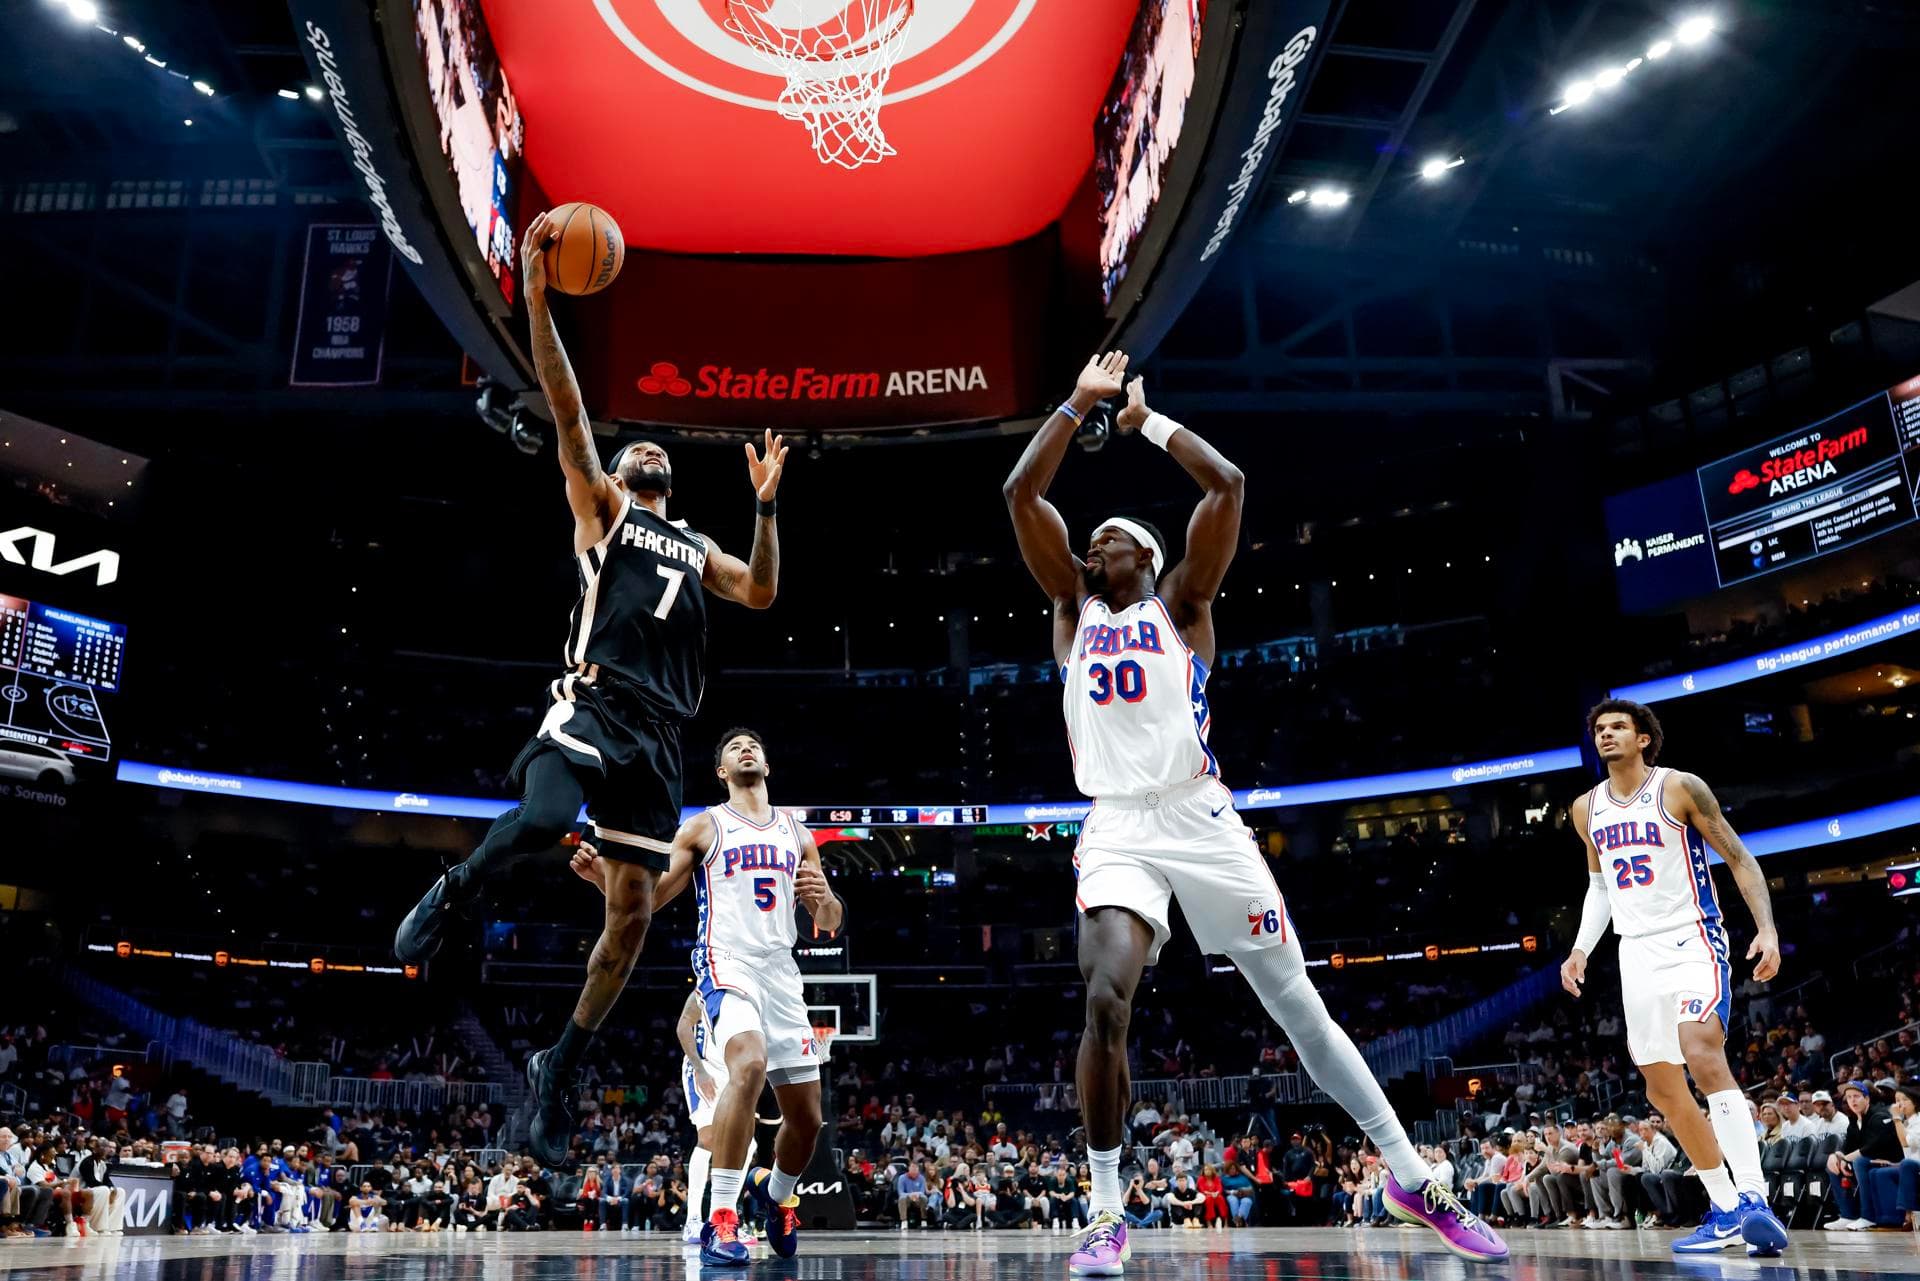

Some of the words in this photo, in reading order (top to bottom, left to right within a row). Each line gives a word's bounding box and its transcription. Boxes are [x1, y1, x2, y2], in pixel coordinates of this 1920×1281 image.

[885, 366, 989, 397] ARENA
[1769, 437, 1809, 458] WELCOME
[1809, 432, 1821, 444] TO
[1769, 459, 1837, 497] ARENA
[1646, 532, 1674, 549] KAISER
[1648, 533, 1705, 558] PERMANENTE
[653, 563, 686, 621] 7
[1080, 620, 1165, 661] PHILA
[1756, 645, 1821, 671] Big-league
[1824, 620, 1900, 654] performance
[1902, 611, 1920, 628] for
[1088, 659, 1147, 706] 30
[1452, 759, 1534, 782] globalpayments
[15, 784, 66, 807] Sorento
[830, 810, 852, 822] 6:50
[892, 810, 908, 822] 13
[1592, 821, 1665, 856] PHILA
[723, 844, 797, 880] PHILA
[1612, 854, 1654, 889] 25
[753, 877, 776, 912] 5
[1247, 909, 1279, 936] 76
[809, 947, 843, 956] TISSOT
[1680, 998, 1703, 1015] 76
[797, 1181, 842, 1195] KIA
